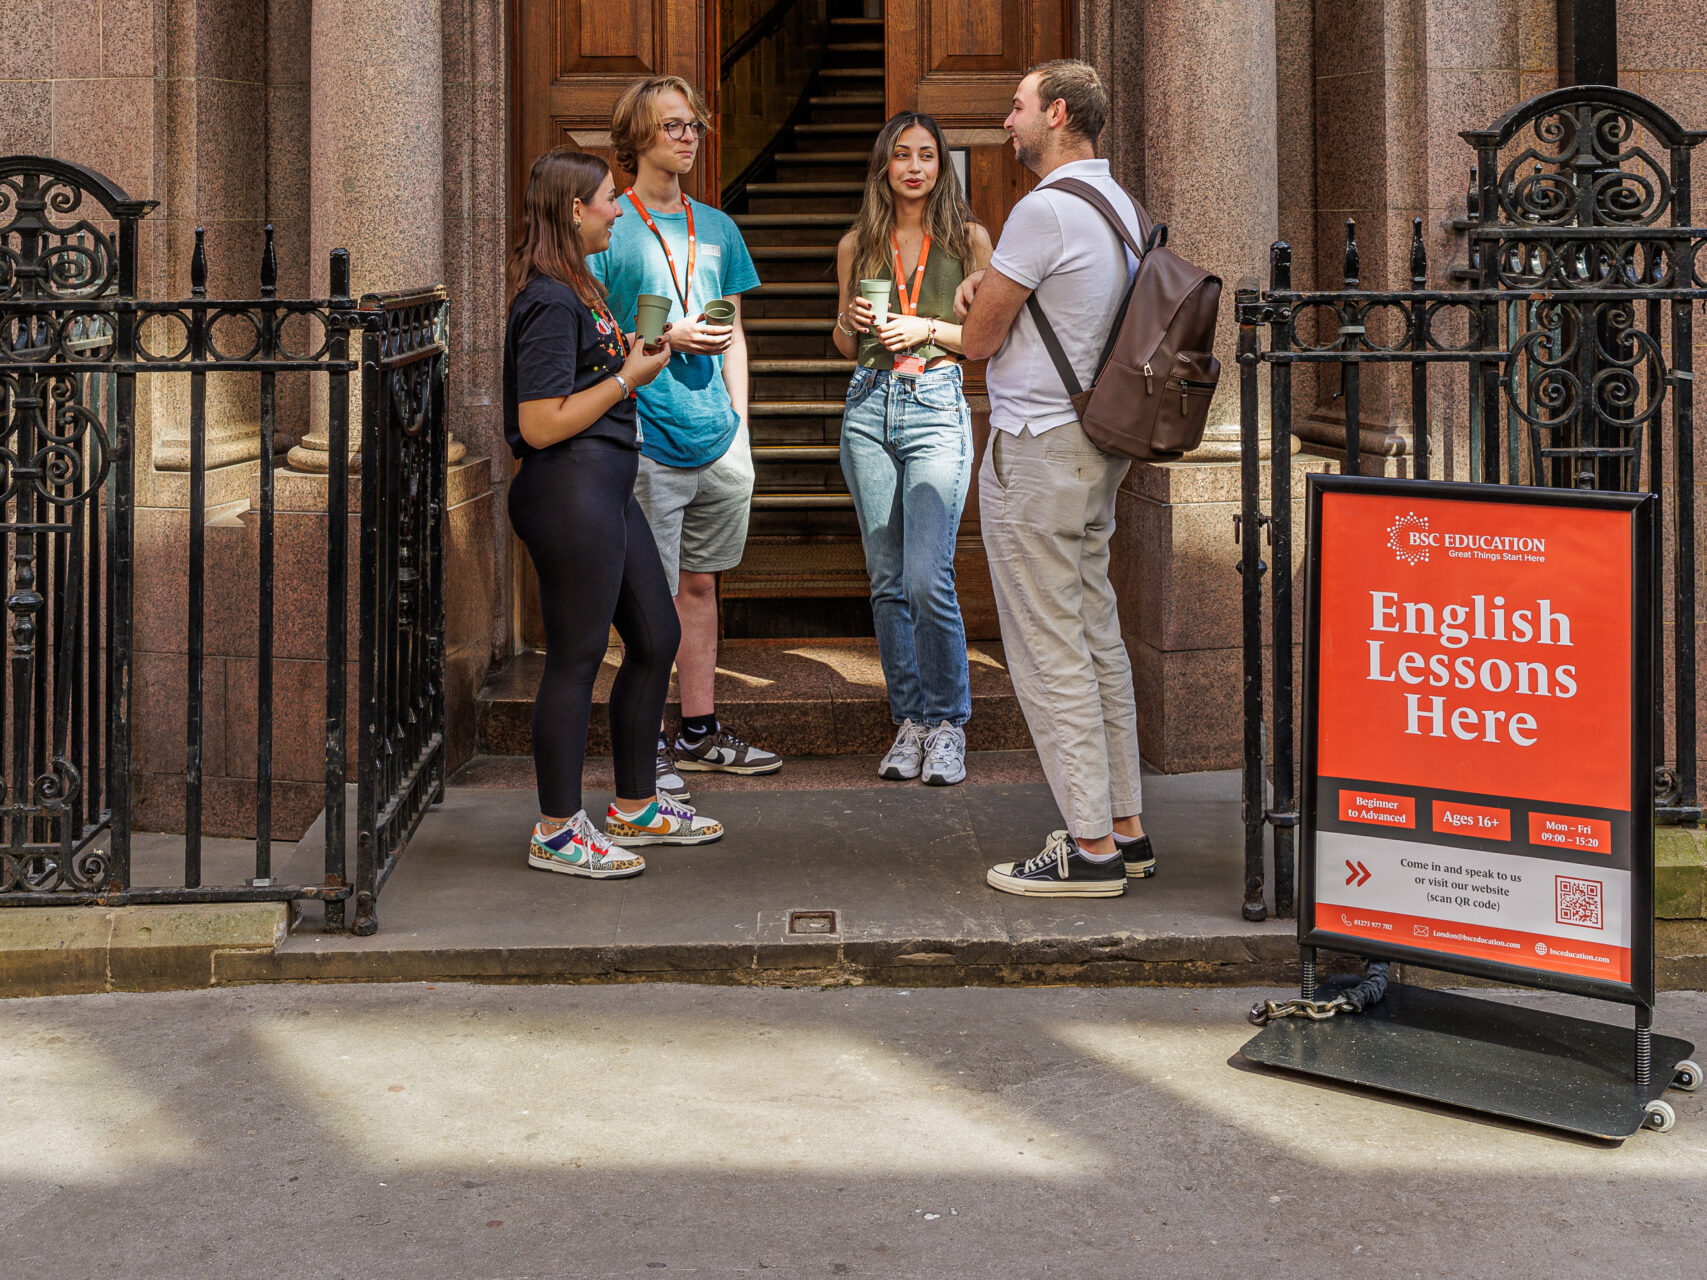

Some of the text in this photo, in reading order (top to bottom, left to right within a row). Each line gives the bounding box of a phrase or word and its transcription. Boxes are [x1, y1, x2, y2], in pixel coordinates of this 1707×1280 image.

[1409, 531, 1545, 552] BSC EDUCATION
[1449, 550, 1545, 562] Great Things Start Here
[1369, 590, 1574, 648] English
[1366, 639, 1578, 698] Lessons
[1403, 693, 1538, 746] Here
[1356, 796, 1398, 809] Beginner
[1348, 809, 1406, 823] to Advanced
[1443, 811, 1499, 827] Ages 16+
[1546, 821, 1568, 831] Mon
[1578, 825, 1591, 834] Fri
[1541, 832, 1565, 843] 09:00
[1576, 836, 1599, 847] 15:20
[1400, 858, 1522, 882] Come in and speak to us
[1414, 876, 1510, 896] or visit our website
[1426, 892, 1500, 912] (scan QR code)
[1433, 930, 1520, 949] London@bsceducation.com
[1550, 948, 1610, 963] bsceducation.com
